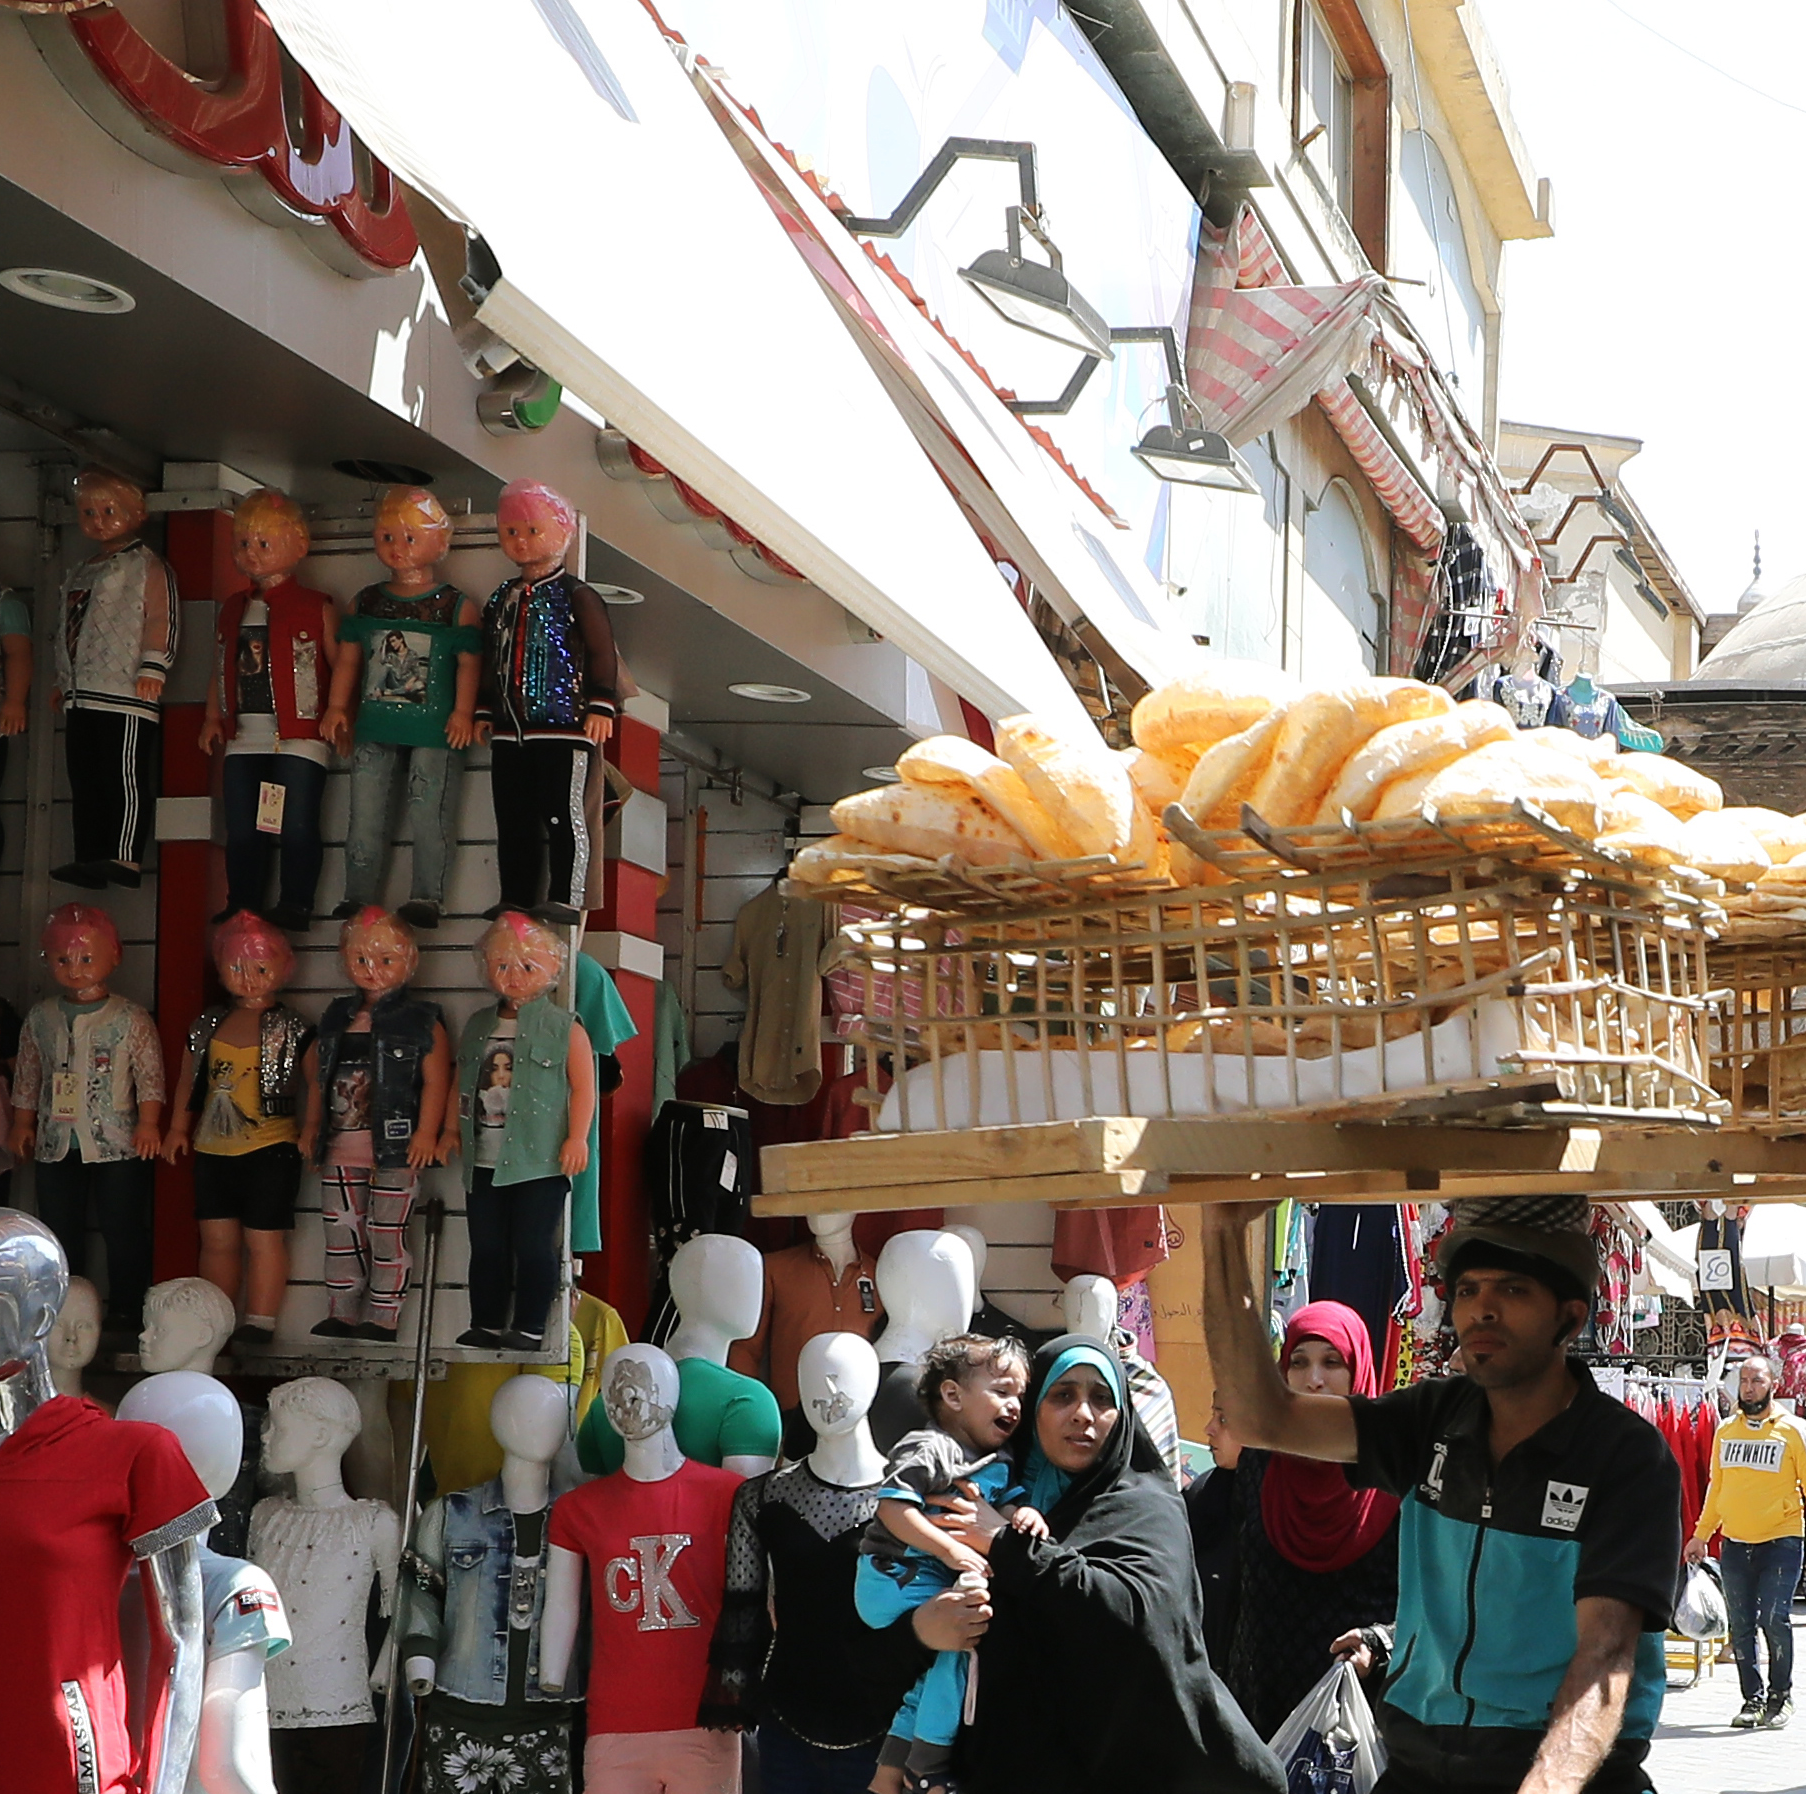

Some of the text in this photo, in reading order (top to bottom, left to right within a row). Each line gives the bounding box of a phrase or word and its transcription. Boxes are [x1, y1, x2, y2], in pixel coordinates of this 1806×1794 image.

[1725, 1443, 1777, 1464] OFF WHITE
[69, 1700, 94, 1779] MASSA
